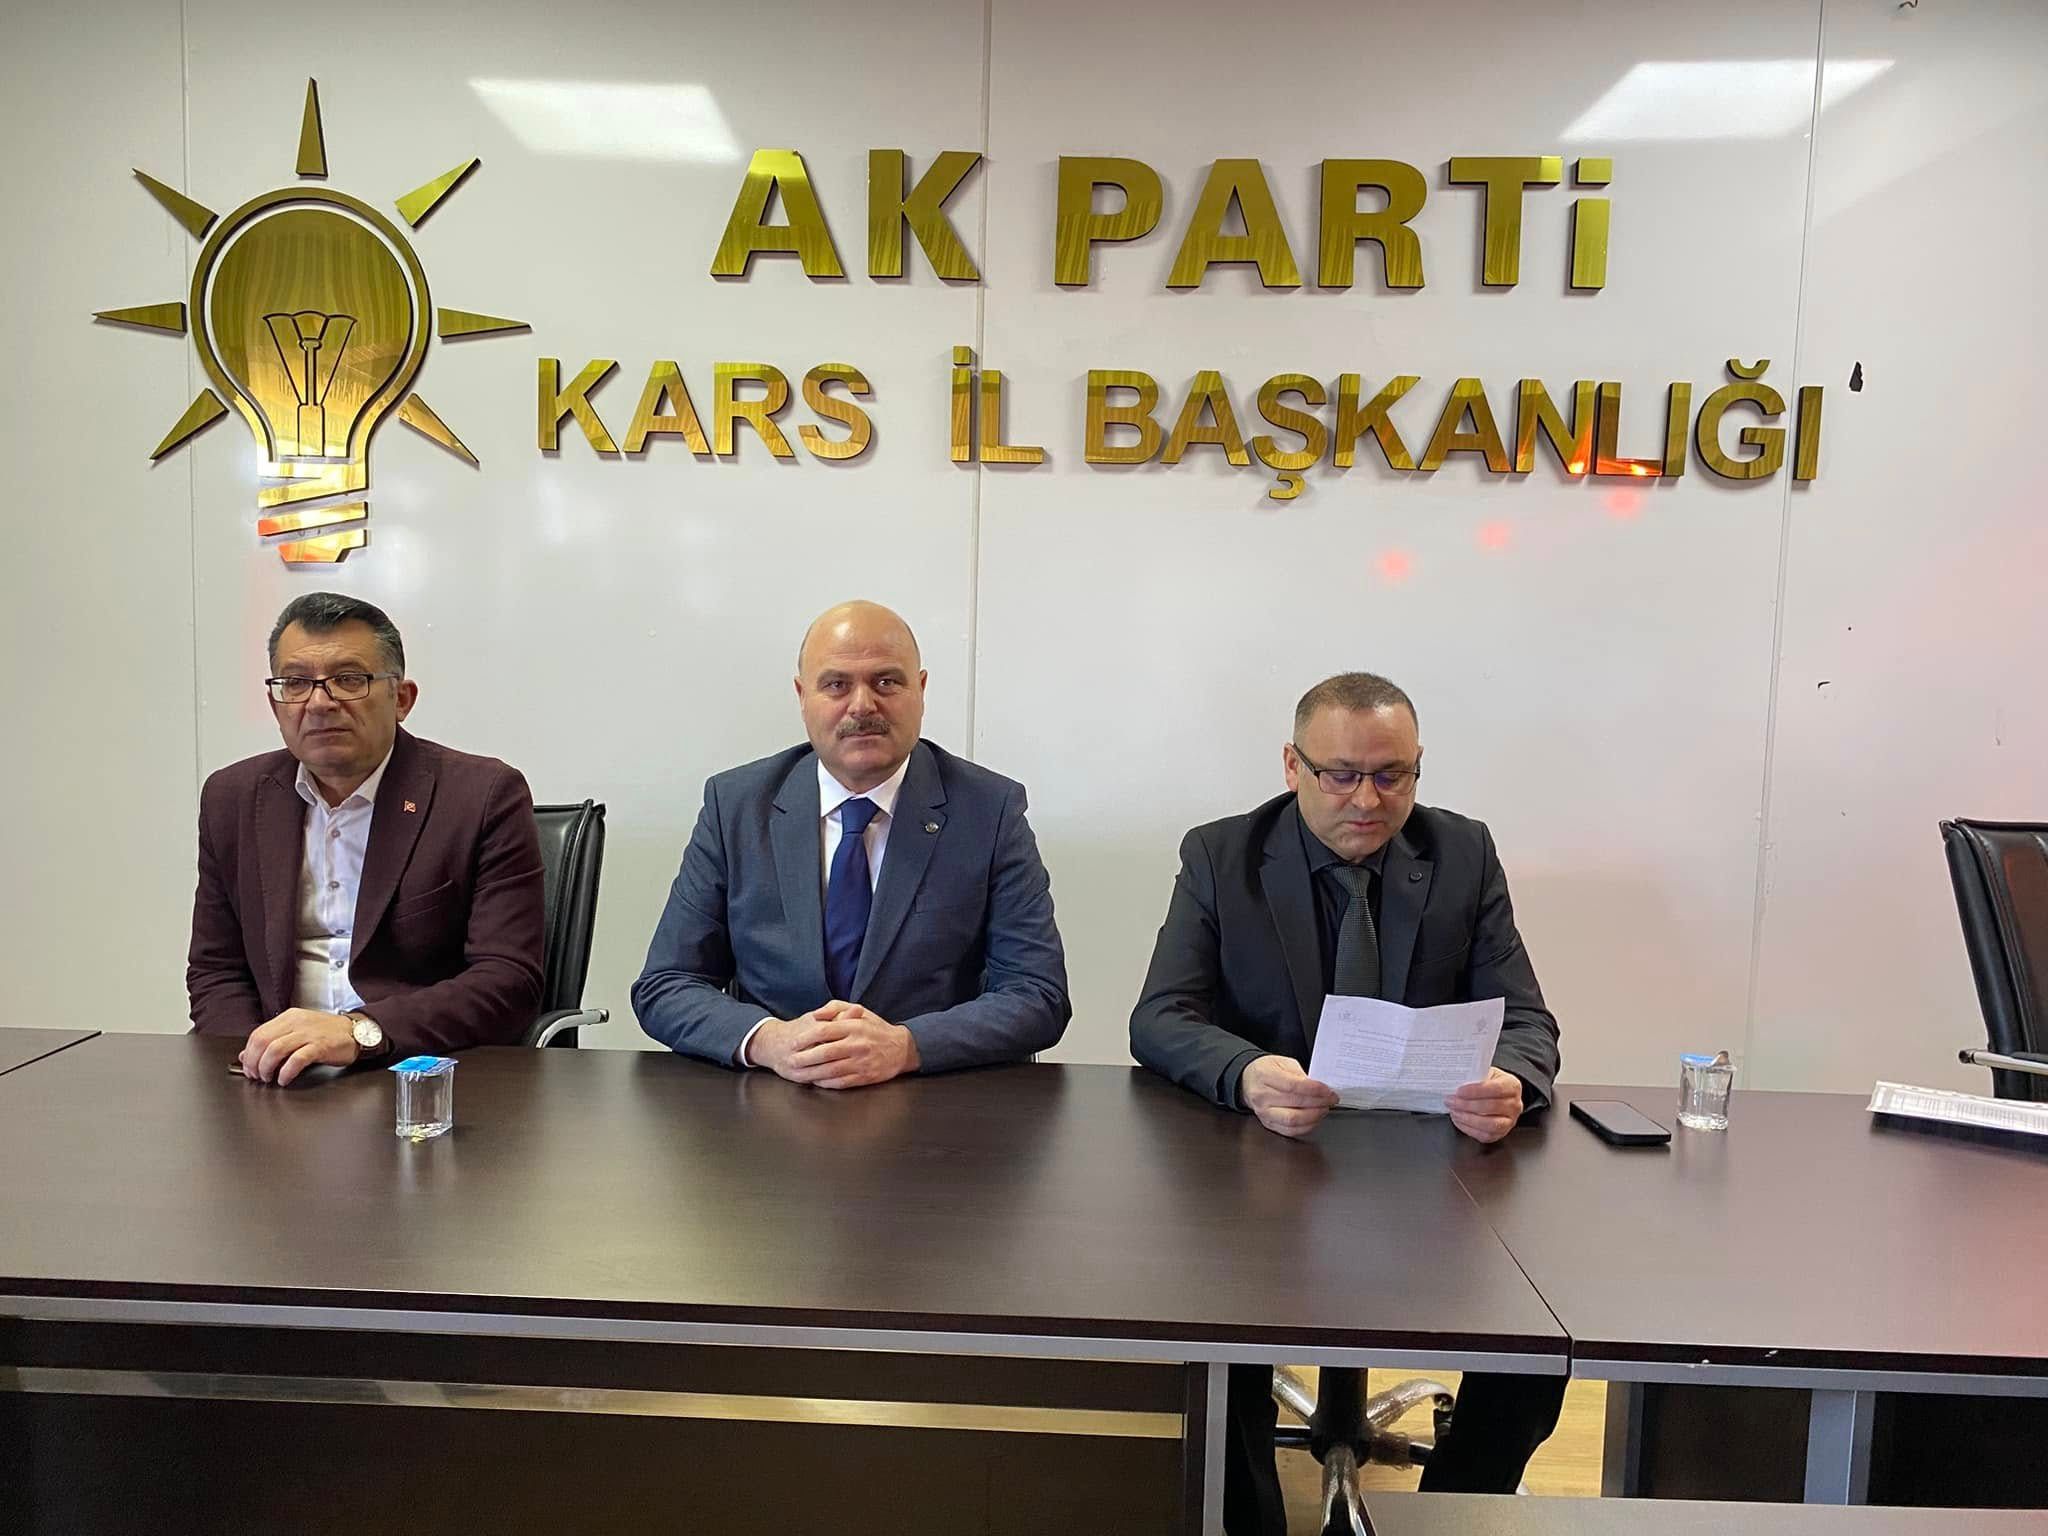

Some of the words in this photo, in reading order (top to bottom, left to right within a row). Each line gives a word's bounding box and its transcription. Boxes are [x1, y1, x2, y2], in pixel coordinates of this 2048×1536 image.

[711, 148, 982, 283] AK
[538, 358, 871, 460] KARS
[951, 345, 1044, 464] İL
[1084, 358, 1825, 499] BAŞKANLIĞI
